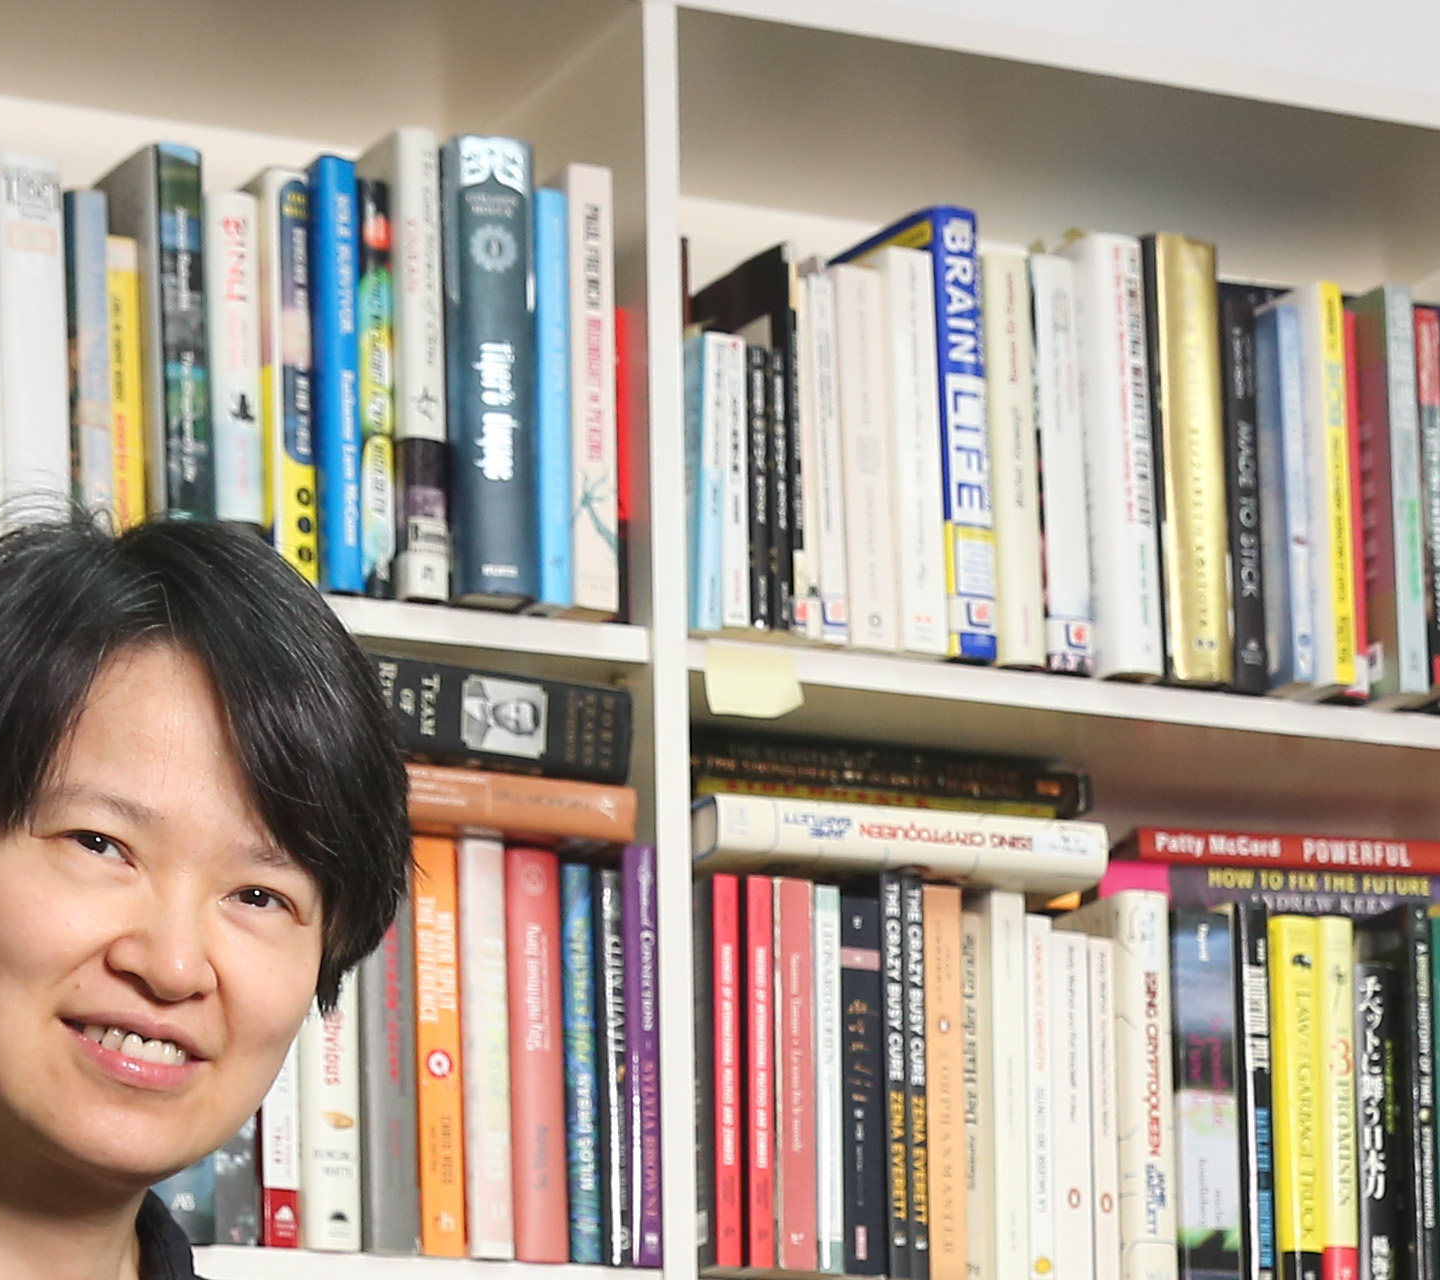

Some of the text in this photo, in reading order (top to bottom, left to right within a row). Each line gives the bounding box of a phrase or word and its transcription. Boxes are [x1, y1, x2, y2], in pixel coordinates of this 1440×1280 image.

[941, 217, 988, 517] BRAIN LIFE
[1236, 421, 1259, 599] MADE TO STICK
[399, 688, 416, 716] OF
[420, 673, 441, 737] TEAM
[1153, 831, 1412, 867] Patty McCord POWERFUL
[1208, 869, 1431, 897] HOW TO FIX THE FUTURE
[420, 930, 440, 1024] DIFFERENCE
[436, 911, 457, 1010] NEVER SPLIT
[884, 883, 906, 1219] THE CRAZY BUSY CURE ZENA EVERETT
[906, 888, 928, 1224] THE CRAZY BUSY CURE ZENA EVERETT
[1144, 1024, 1162, 1157] CRYPTOQUEEN
[1417, 1003, 1433, 1106] HISTORY OF TIME
[577, 1073, 594, 1134] URBAN
[964, 1091, 979, 1125] Der
[1297, 990, 1317, 1240] LAW GARBAGE TRUCK
[1333, 1079, 1353, 1208] PROMISES
[1421, 1125, 1437, 1229] STEPHEN HAWKING
